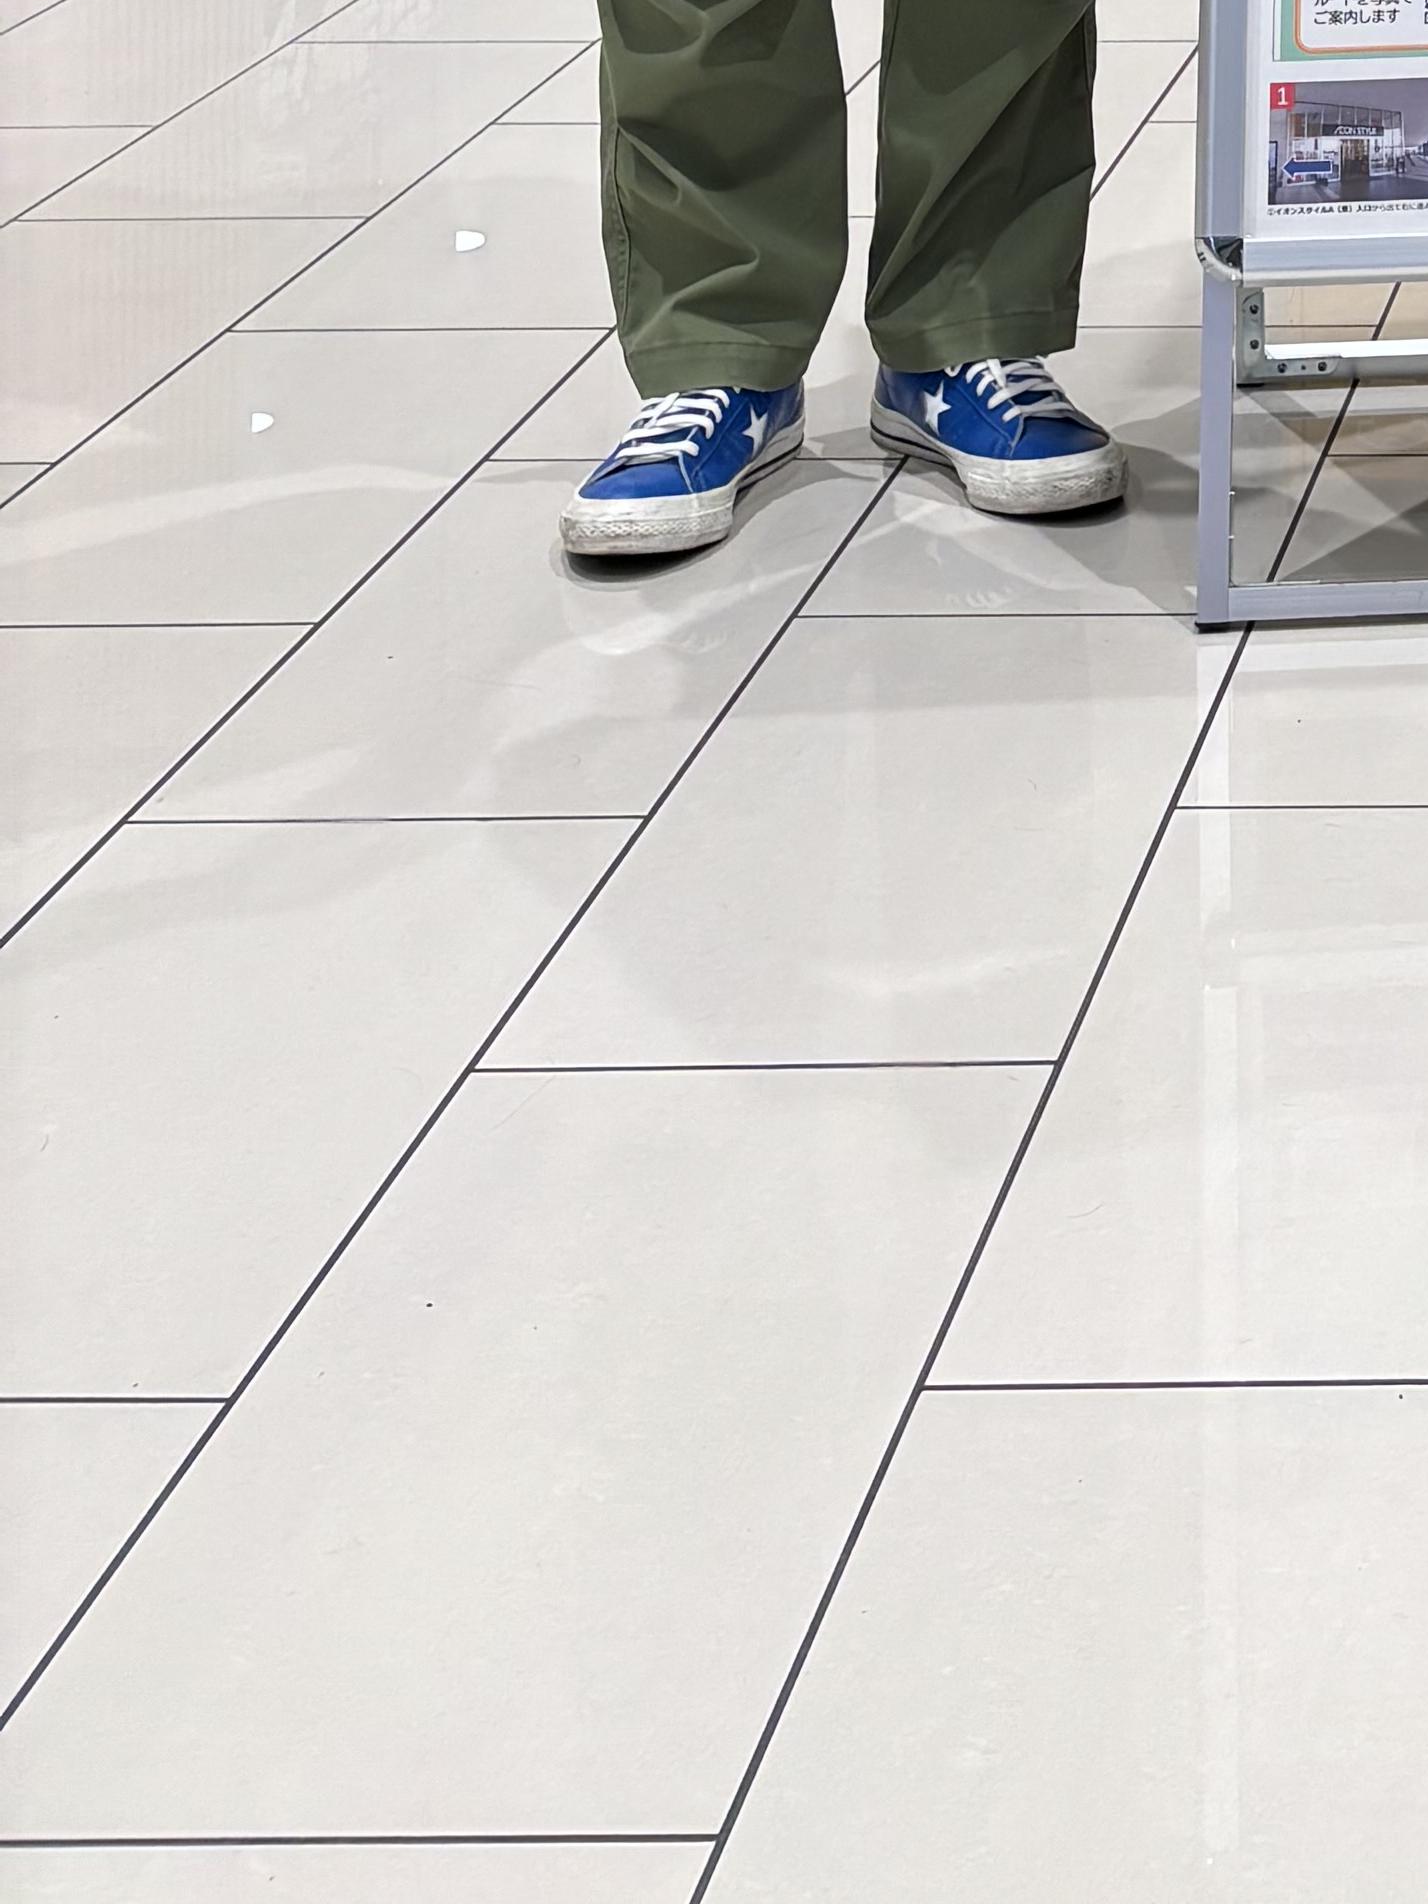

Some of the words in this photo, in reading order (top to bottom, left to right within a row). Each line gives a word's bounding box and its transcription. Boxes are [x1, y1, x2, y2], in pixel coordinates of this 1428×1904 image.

[1313, 8, 1400, 25] ご案内します
[1277, 87, 1289, 106] 1
